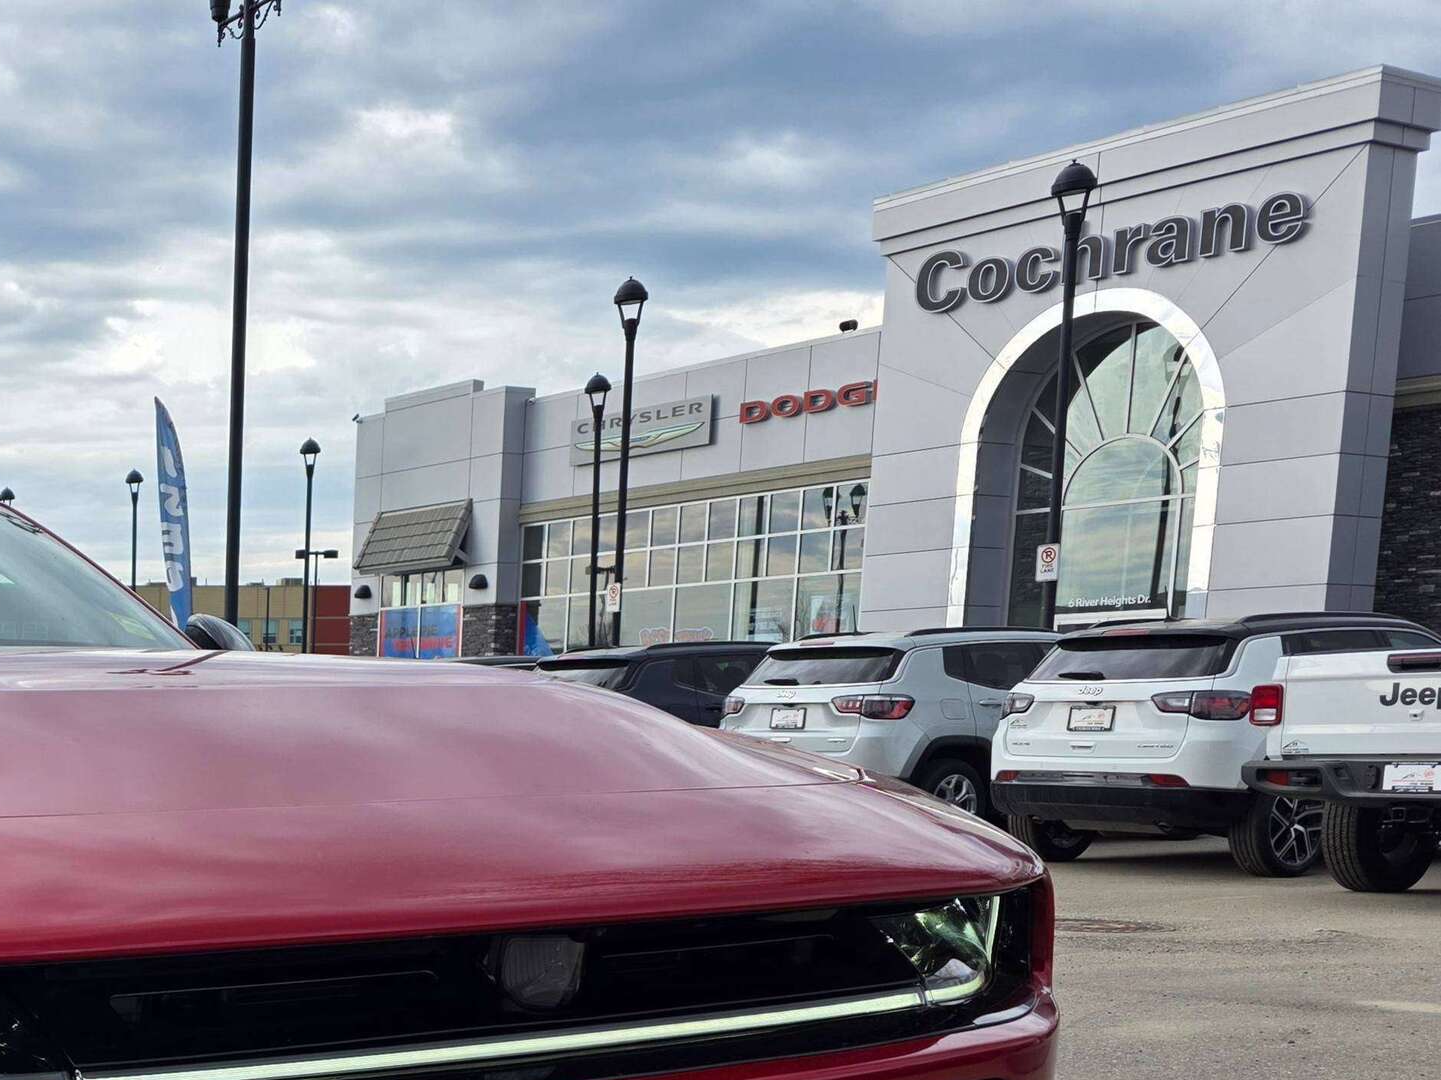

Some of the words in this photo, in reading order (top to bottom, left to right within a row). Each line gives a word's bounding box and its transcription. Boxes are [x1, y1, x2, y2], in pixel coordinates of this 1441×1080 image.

[915, 191, 1307, 314] Cochrane
[738, 379, 878, 424] DODG
[1075, 597, 1099, 608] River
[1100, 594, 1137, 608] Heights
[1137, 594, 1152, 605] Dr.
[1078, 686, 1103, 696] Jeep
[1379, 682, 1441, 710] Jee
